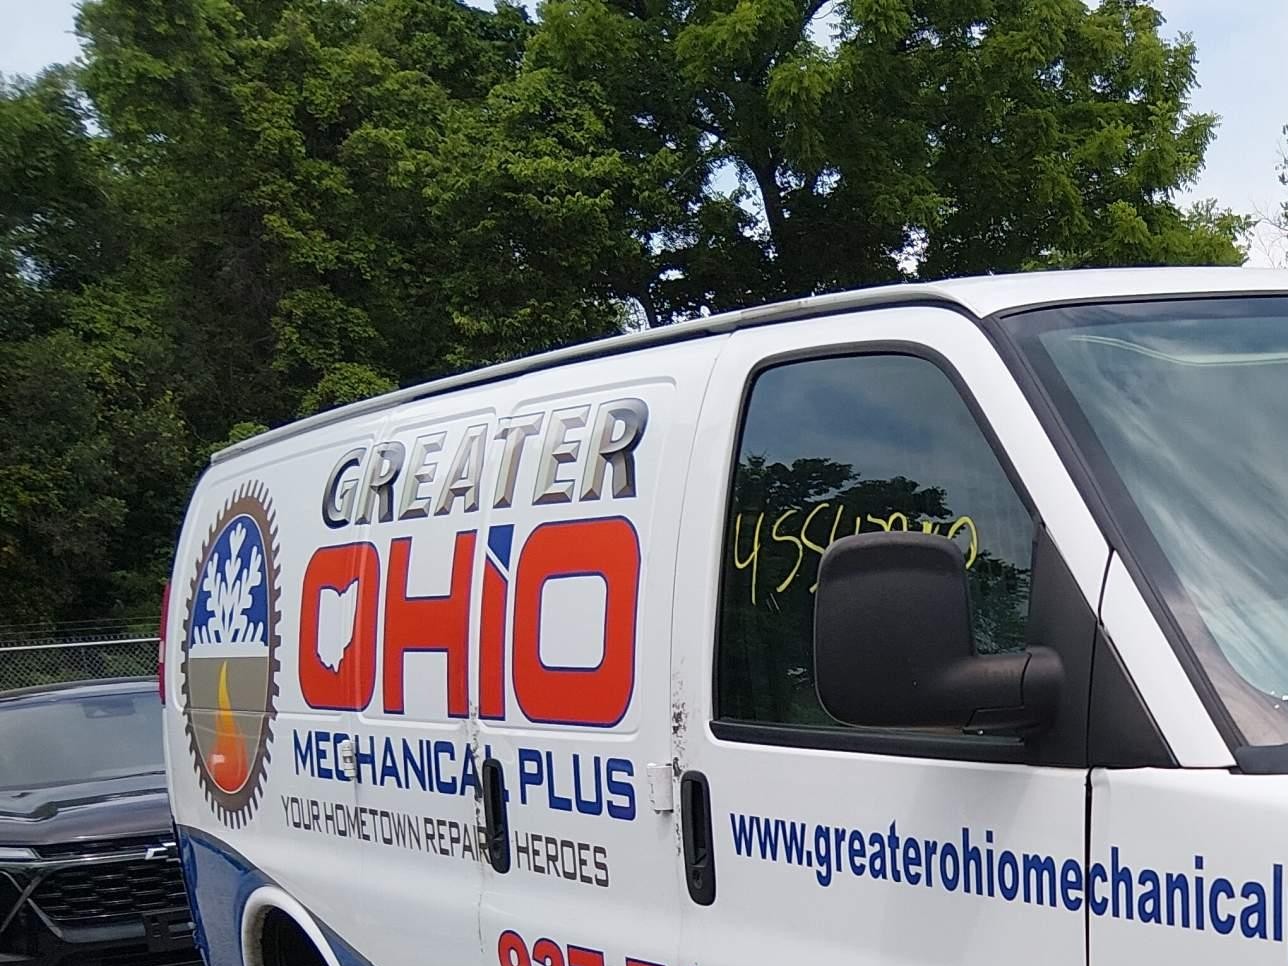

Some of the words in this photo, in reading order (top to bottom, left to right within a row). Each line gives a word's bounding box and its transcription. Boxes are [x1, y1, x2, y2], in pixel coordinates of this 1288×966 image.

[321, 397, 648, 529] GREATER
[518, 748, 636, 821] PLUS
[281, 795, 322, 832] YOUR
[323, 801, 422, 850] HOMETOWN
[423, 817, 492, 864] REPAIR
[514, 830, 610, 887] HEROES
